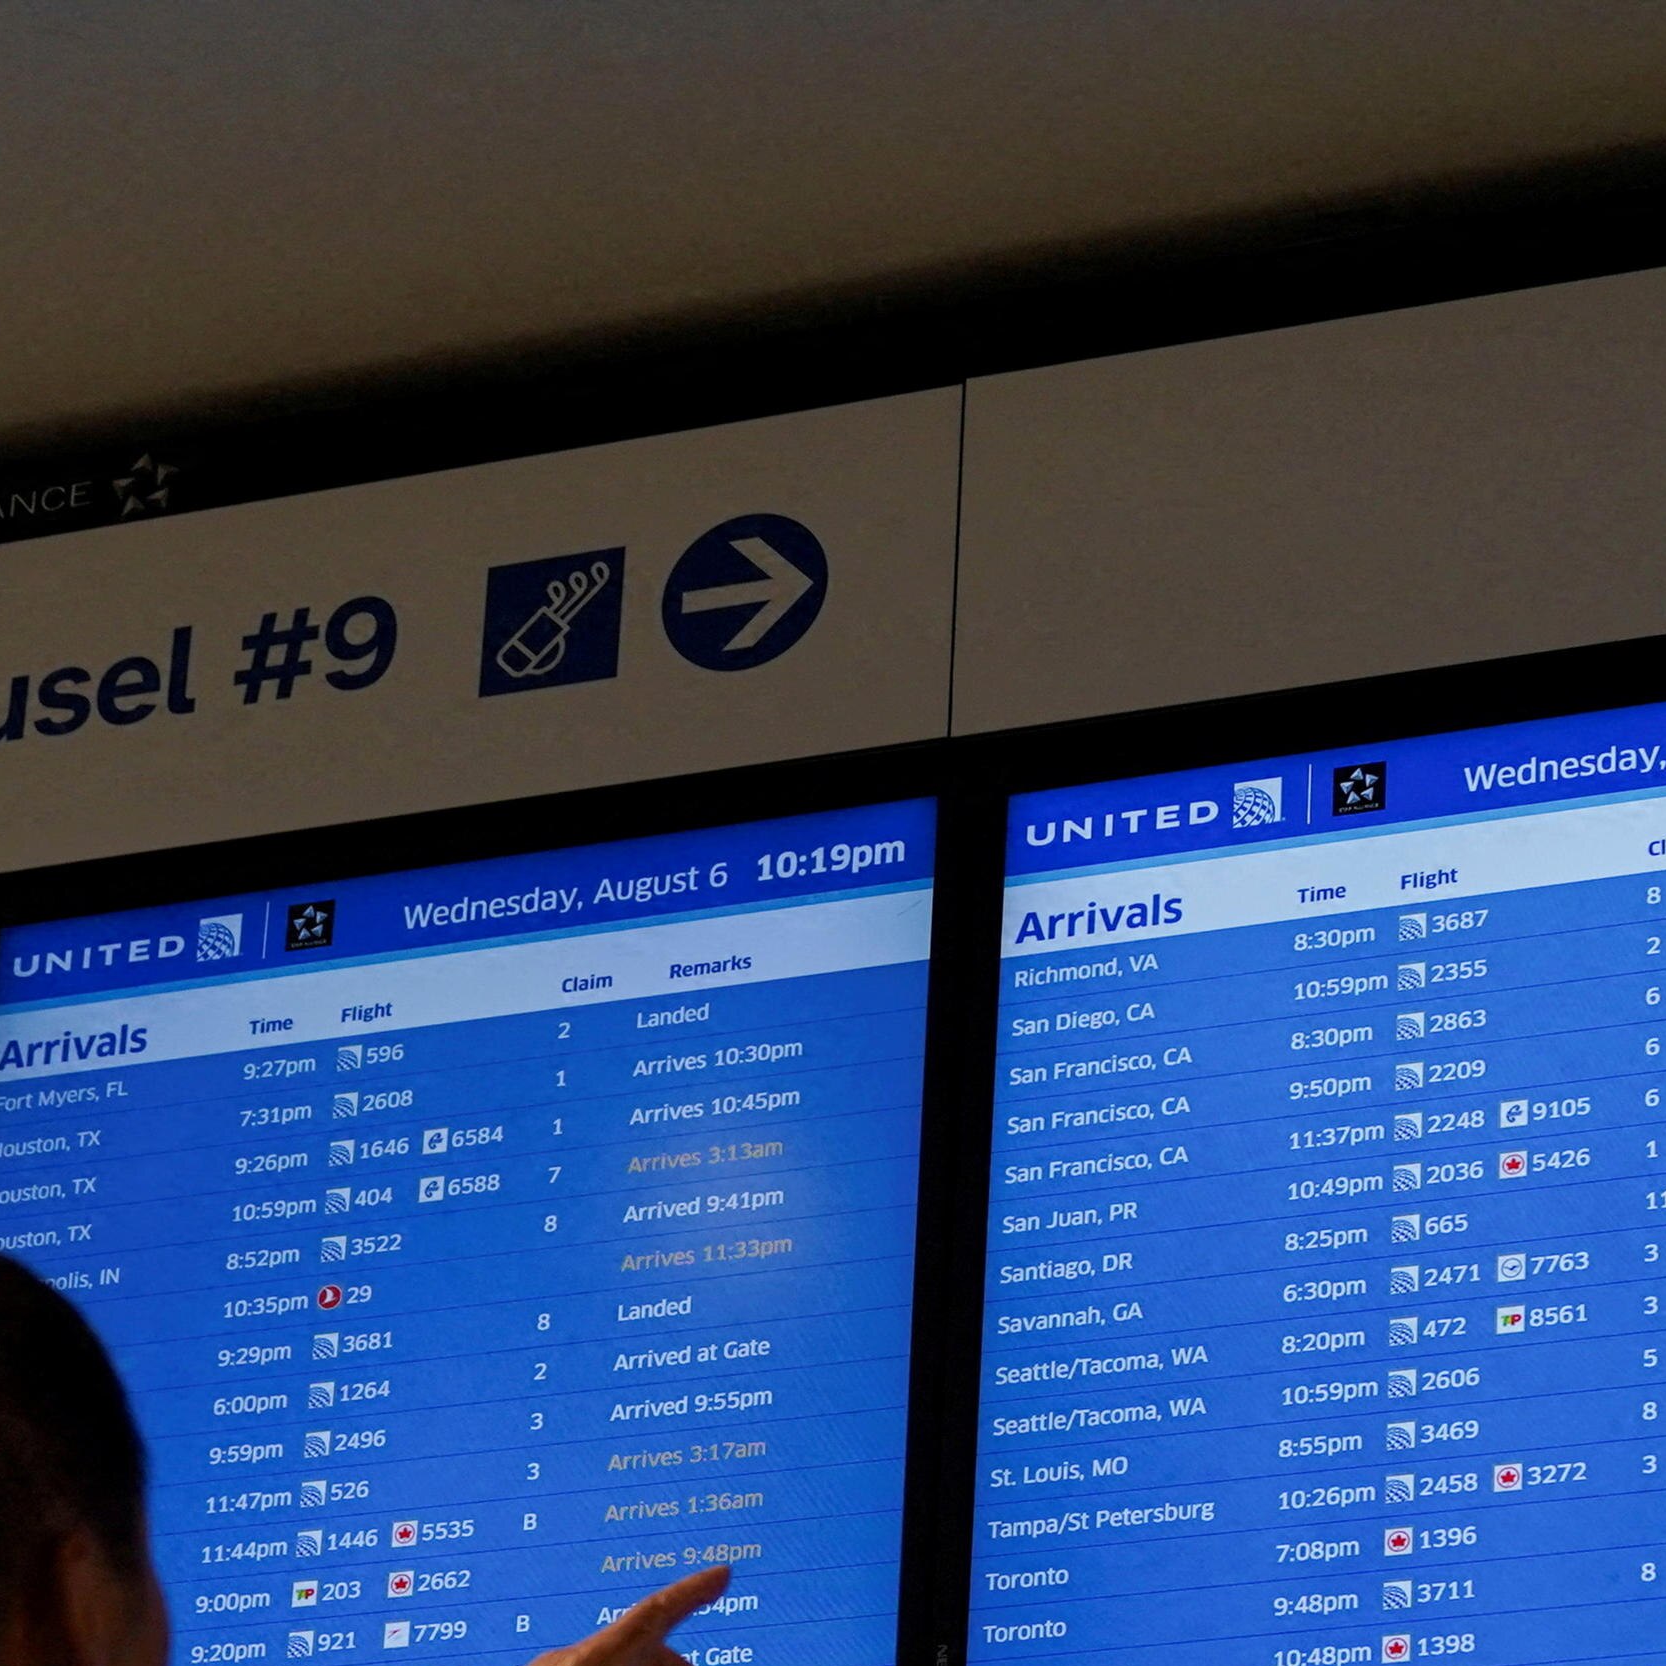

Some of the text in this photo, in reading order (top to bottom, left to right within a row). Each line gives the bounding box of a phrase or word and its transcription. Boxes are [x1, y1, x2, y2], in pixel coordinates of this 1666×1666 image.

[232, 595, 400, 707] #9
[1463, 745, 1666, 792] Wednesday,
[1026, 800, 1219, 847] UNITED
[404, 840, 906, 930] Wednesday, August 6 10:19pm
[1400, 868, 1459, 891] Flight
[1296, 885, 1347, 904] Time
[1646, 886, 1662, 905] 8
[1014, 893, 1183, 945] Arrivals
[1431, 908, 1489, 934] 3687
[1293, 927, 1376, 952] 8:30pm
[13, 935, 186, 978] UNITED
[669, 954, 752, 980] Remarks
[1009, 949, 1159, 988] Richmond, VA
[561, 973, 613, 994] Claim
[340, 1002, 393, 1023] Flight
[636, 1002, 710, 1029] Landed
[248, 1017, 294, 1036] Time
[557, 1021, 571, 1040] 2
[366, 1043, 405, 1065] 596
[243, 1057, 317, 1081] 9:27pm
[37, 1086, 100, 1109] Myers,
[105, 1080, 129, 1099] FL
